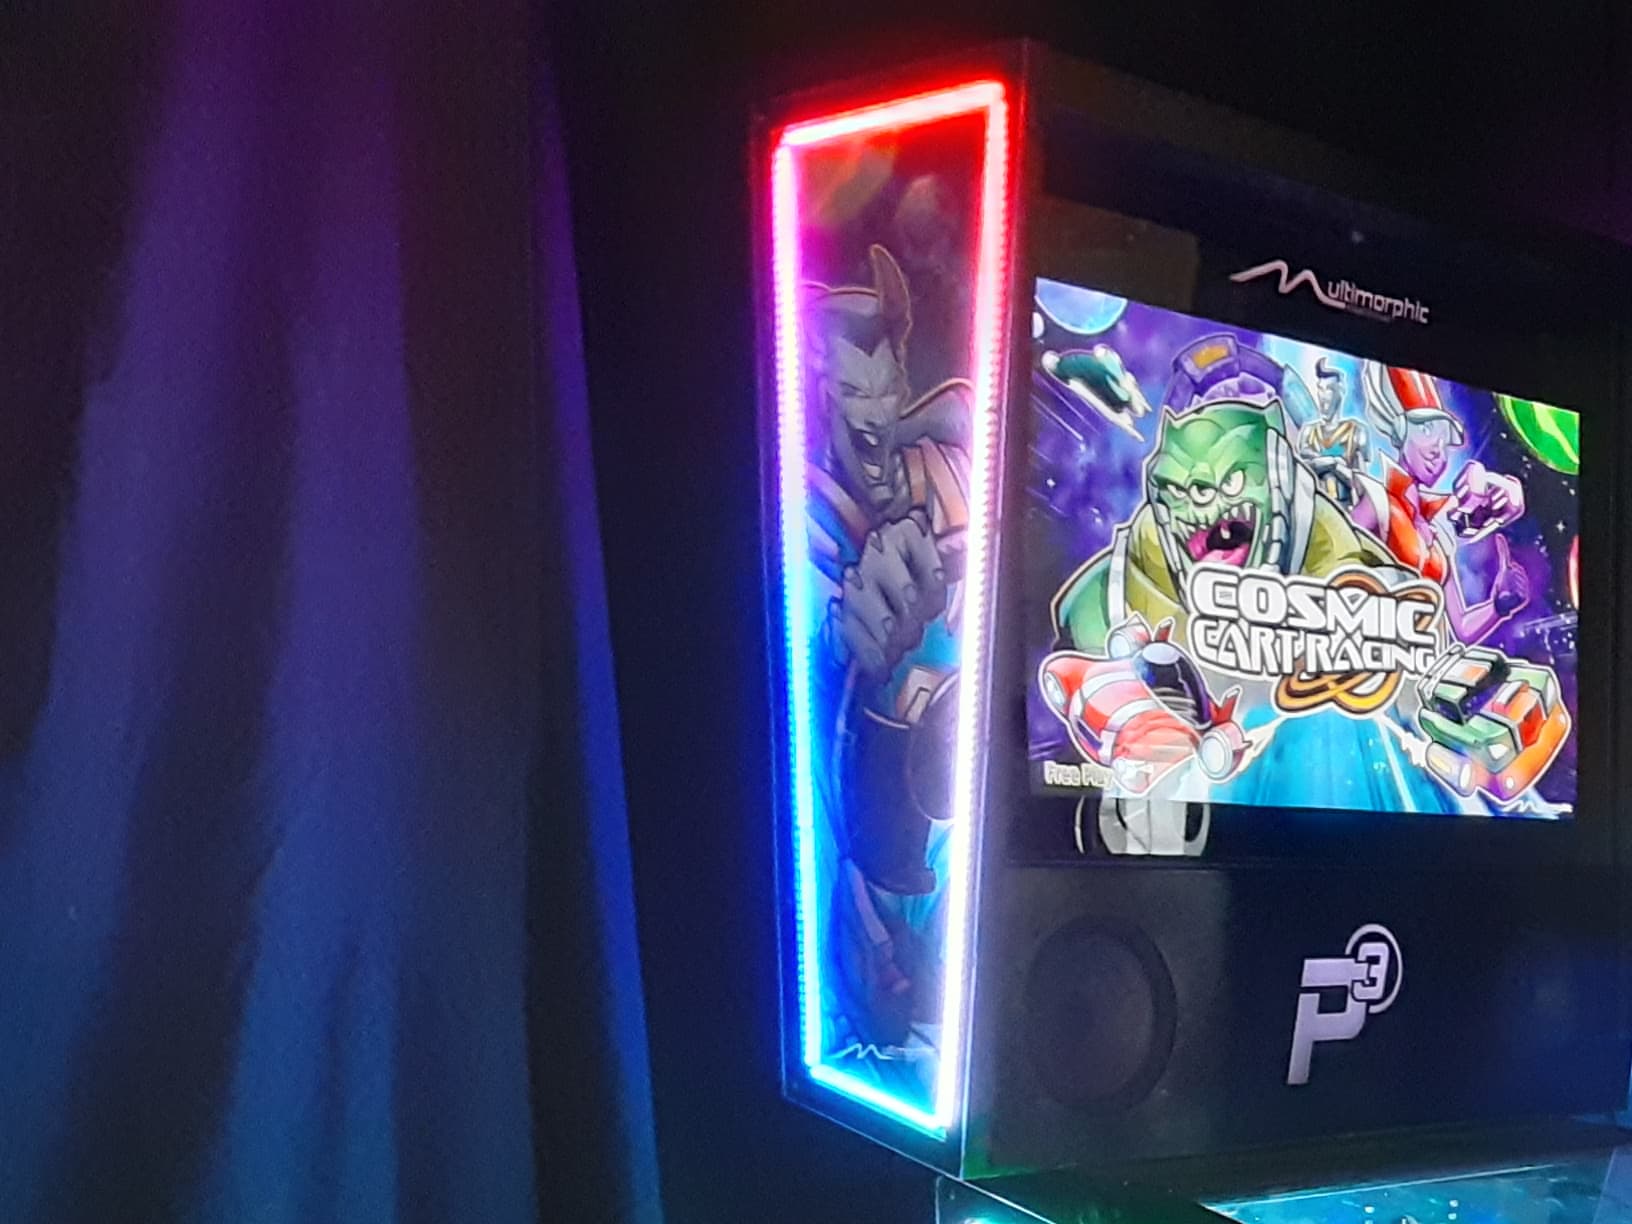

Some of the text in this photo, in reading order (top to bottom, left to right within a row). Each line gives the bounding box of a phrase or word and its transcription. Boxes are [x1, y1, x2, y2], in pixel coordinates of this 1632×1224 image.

[1230, 259, 1430, 324] Multimorphic
[1191, 568, 1436, 645] COSMIC
[1044, 760, 1080, 787] Free
